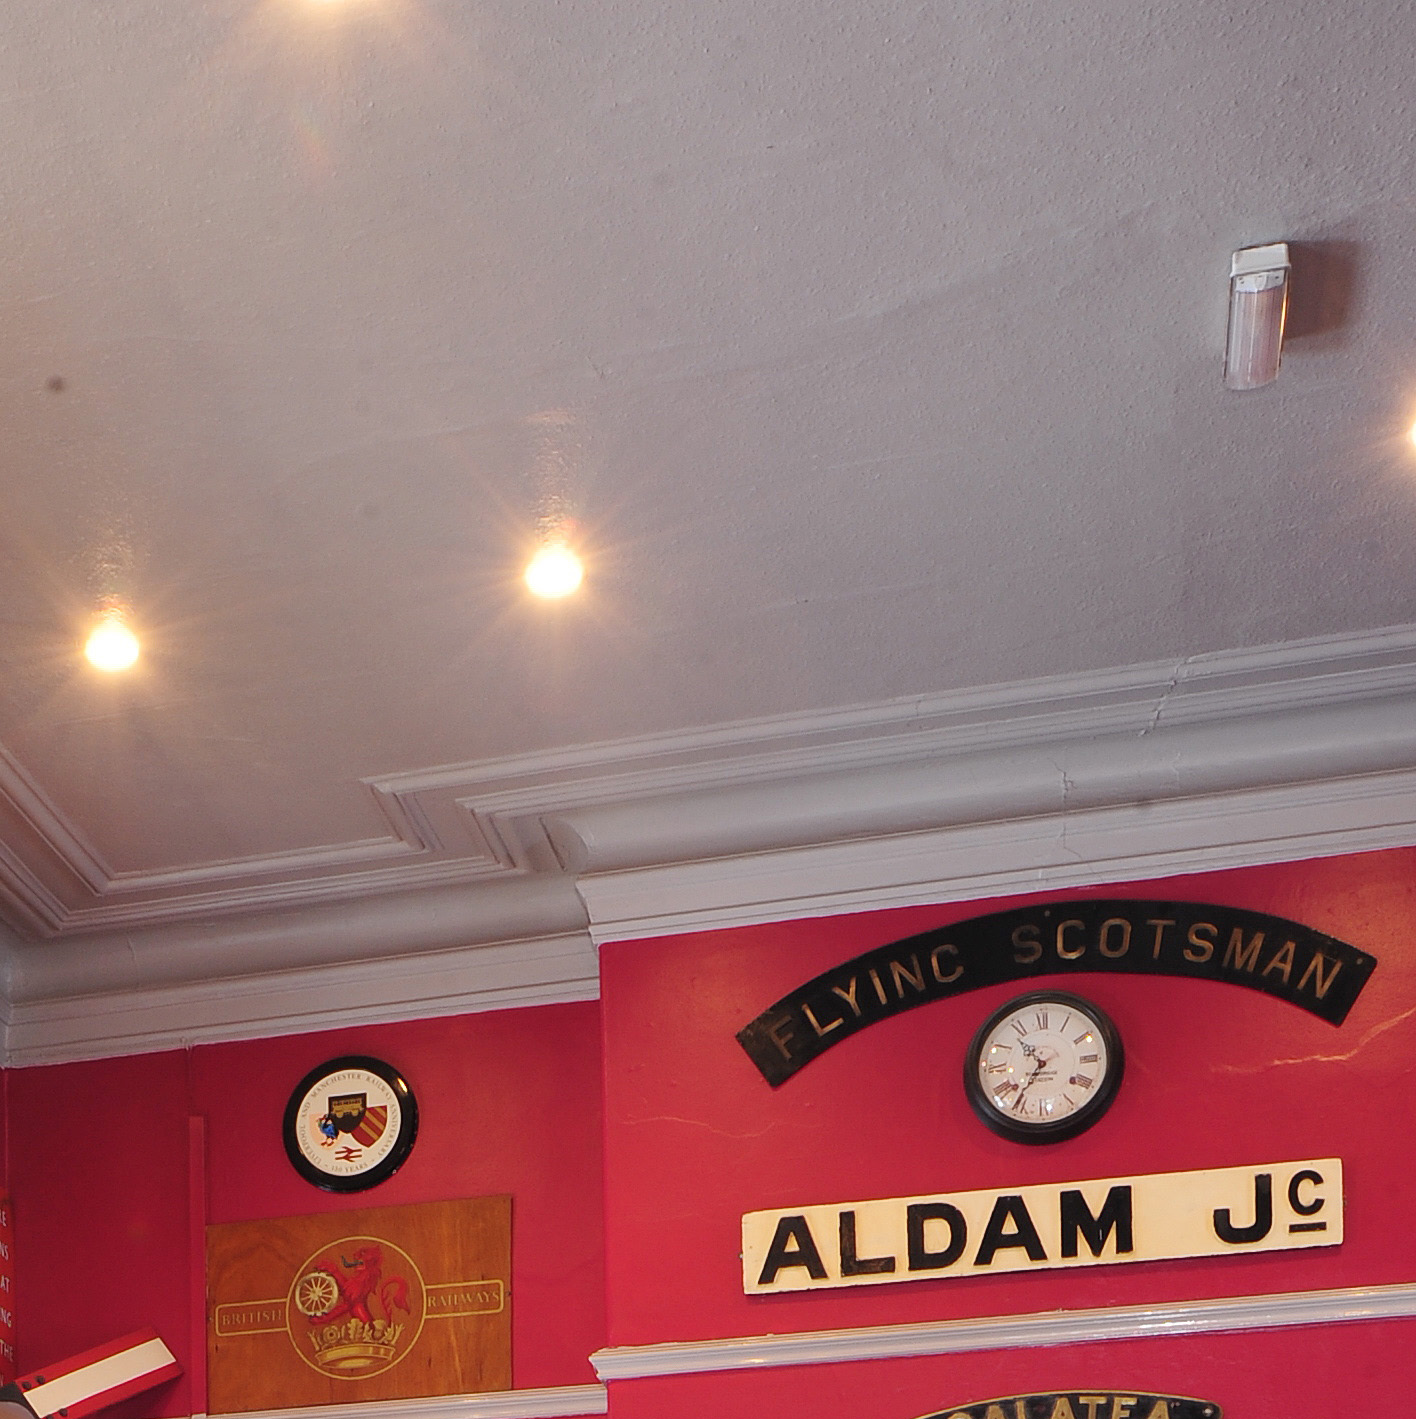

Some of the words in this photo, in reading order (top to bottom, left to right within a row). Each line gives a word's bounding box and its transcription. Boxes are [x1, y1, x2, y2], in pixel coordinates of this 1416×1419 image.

[767, 942, 966, 1062] FLYING
[1010, 916, 1347, 1001] SCOTSMAN
[756, 1184, 1135, 1285] ALDAM
[0, 1274, 11, 1294] AT
[220, 1308, 283, 1327] BRITISH
[427, 1289, 500, 1309] RAILWAYS
[0, 1337, 14, 1363] THE
